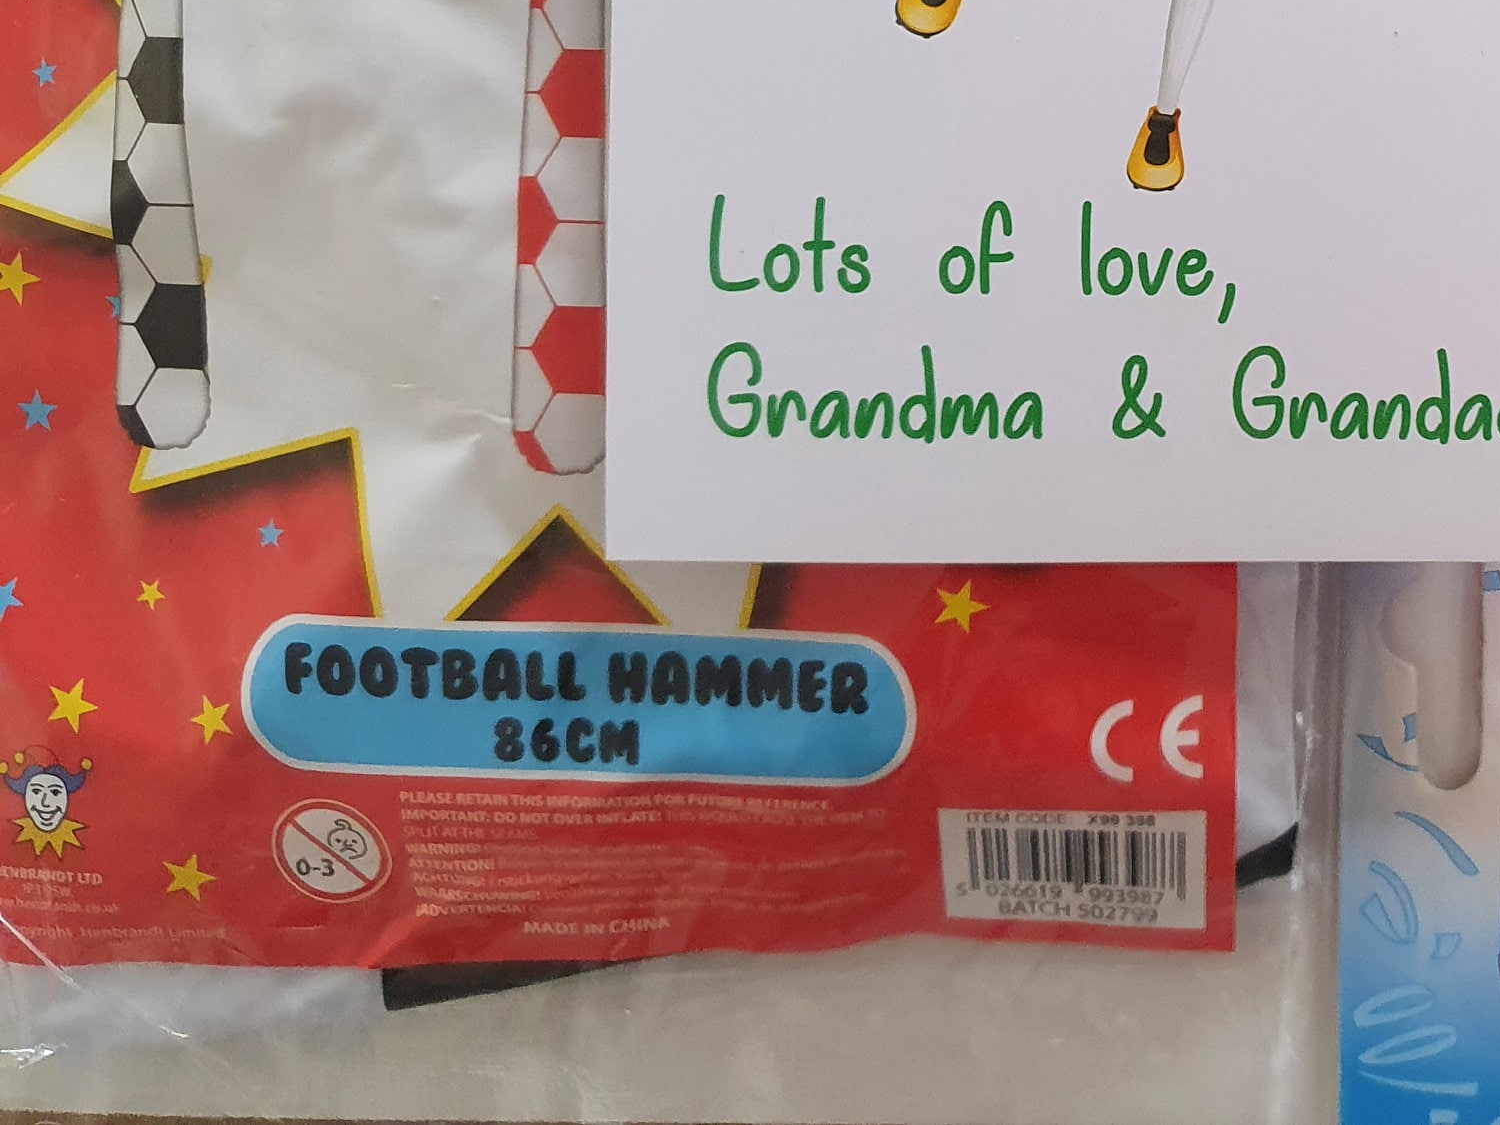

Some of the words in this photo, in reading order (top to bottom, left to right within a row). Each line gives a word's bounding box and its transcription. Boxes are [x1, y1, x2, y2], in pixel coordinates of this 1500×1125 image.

[706, 193, 872, 296] Lots
[937, 199, 1015, 296] of
[1078, 200, 1239, 326] love,
[706, 340, 1044, 446] Grandma
[1110, 354, 1168, 439] &
[284, 641, 588, 702] FOOTBALL
[608, 650, 871, 715] HAMMER
[493, 716, 640, 766] 86CM
[399, 791, 455, 804] PLEASE
[456, 793, 509, 806] RETAIN
[511, 794, 545, 807] THIS
[493, 811, 517, 824] DO
[519, 811, 550, 825] NOT
[295, 857, 336, 877] 0-3
[77, 872, 104, 886] LTD
[998, 898, 1072, 917] BATCH
[523, 921, 579, 935] MADE
[583, 922, 605, 935] IN
